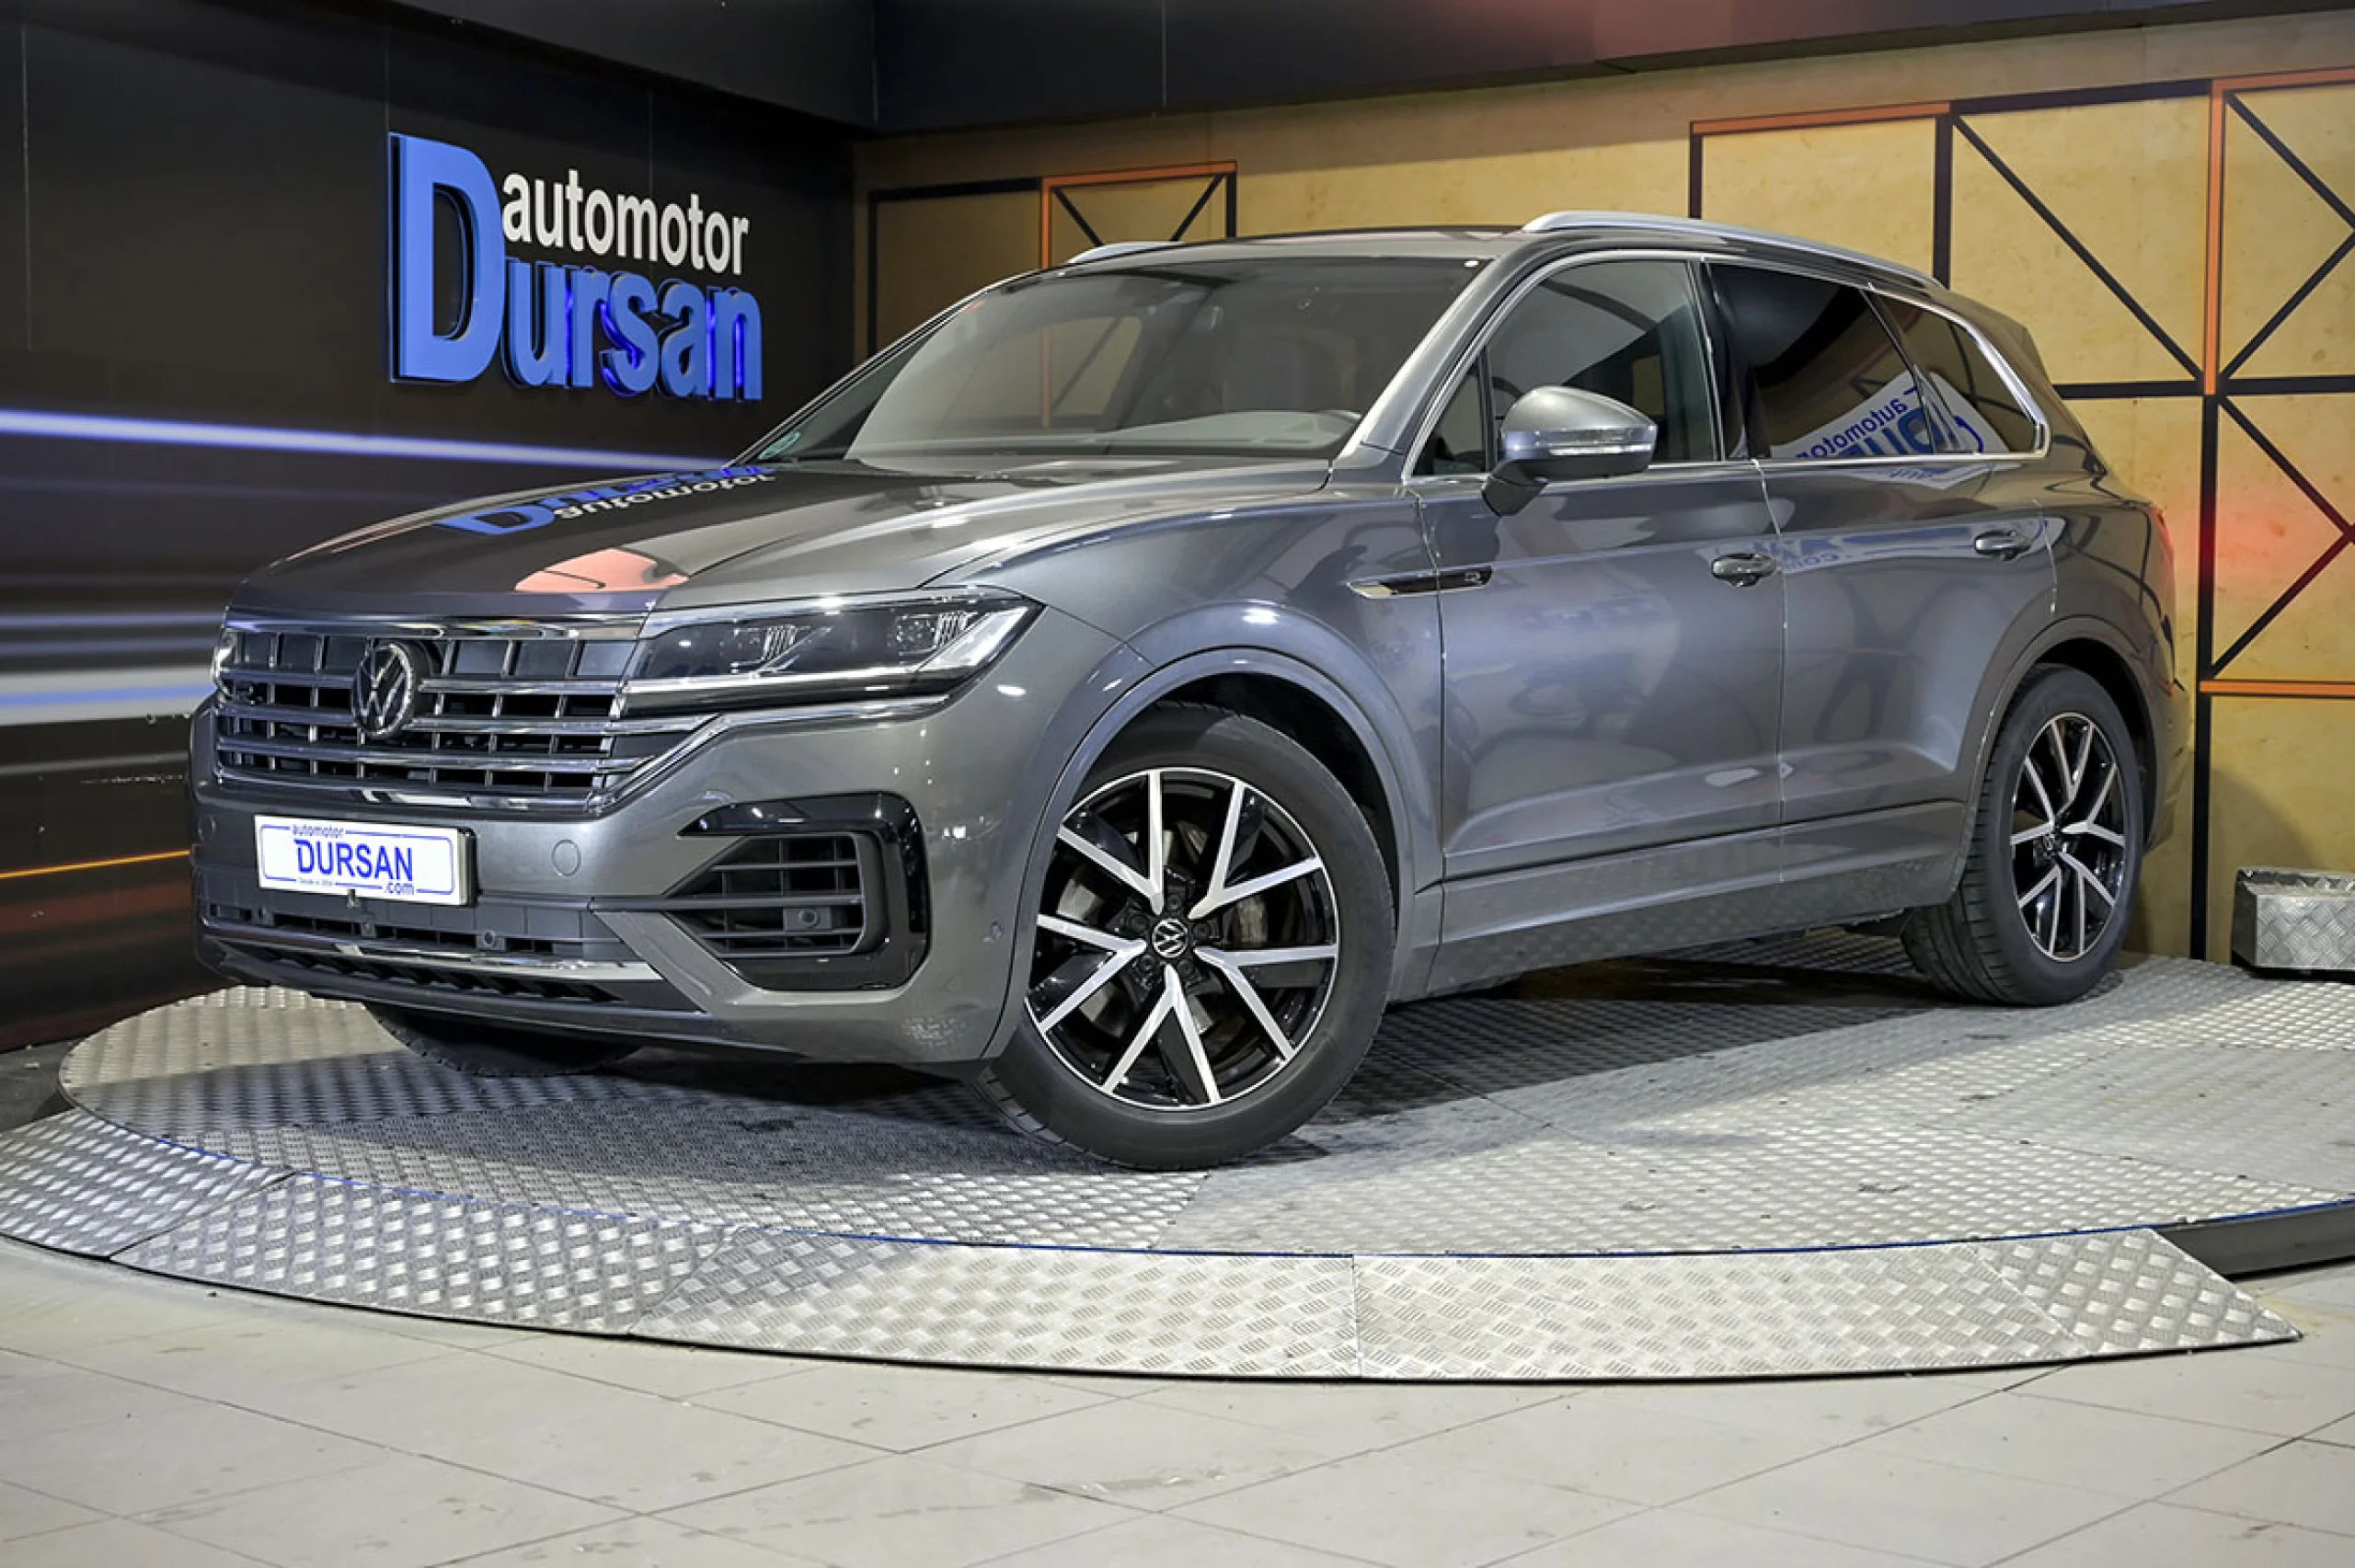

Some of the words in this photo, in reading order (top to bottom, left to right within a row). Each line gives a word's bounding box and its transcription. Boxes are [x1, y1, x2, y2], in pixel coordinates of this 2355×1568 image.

[502, 168, 749, 275] automotor
[388, 131, 763, 402] Dursan
[294, 838, 414, 881] DURSAN
[384, 881, 415, 896] .com
